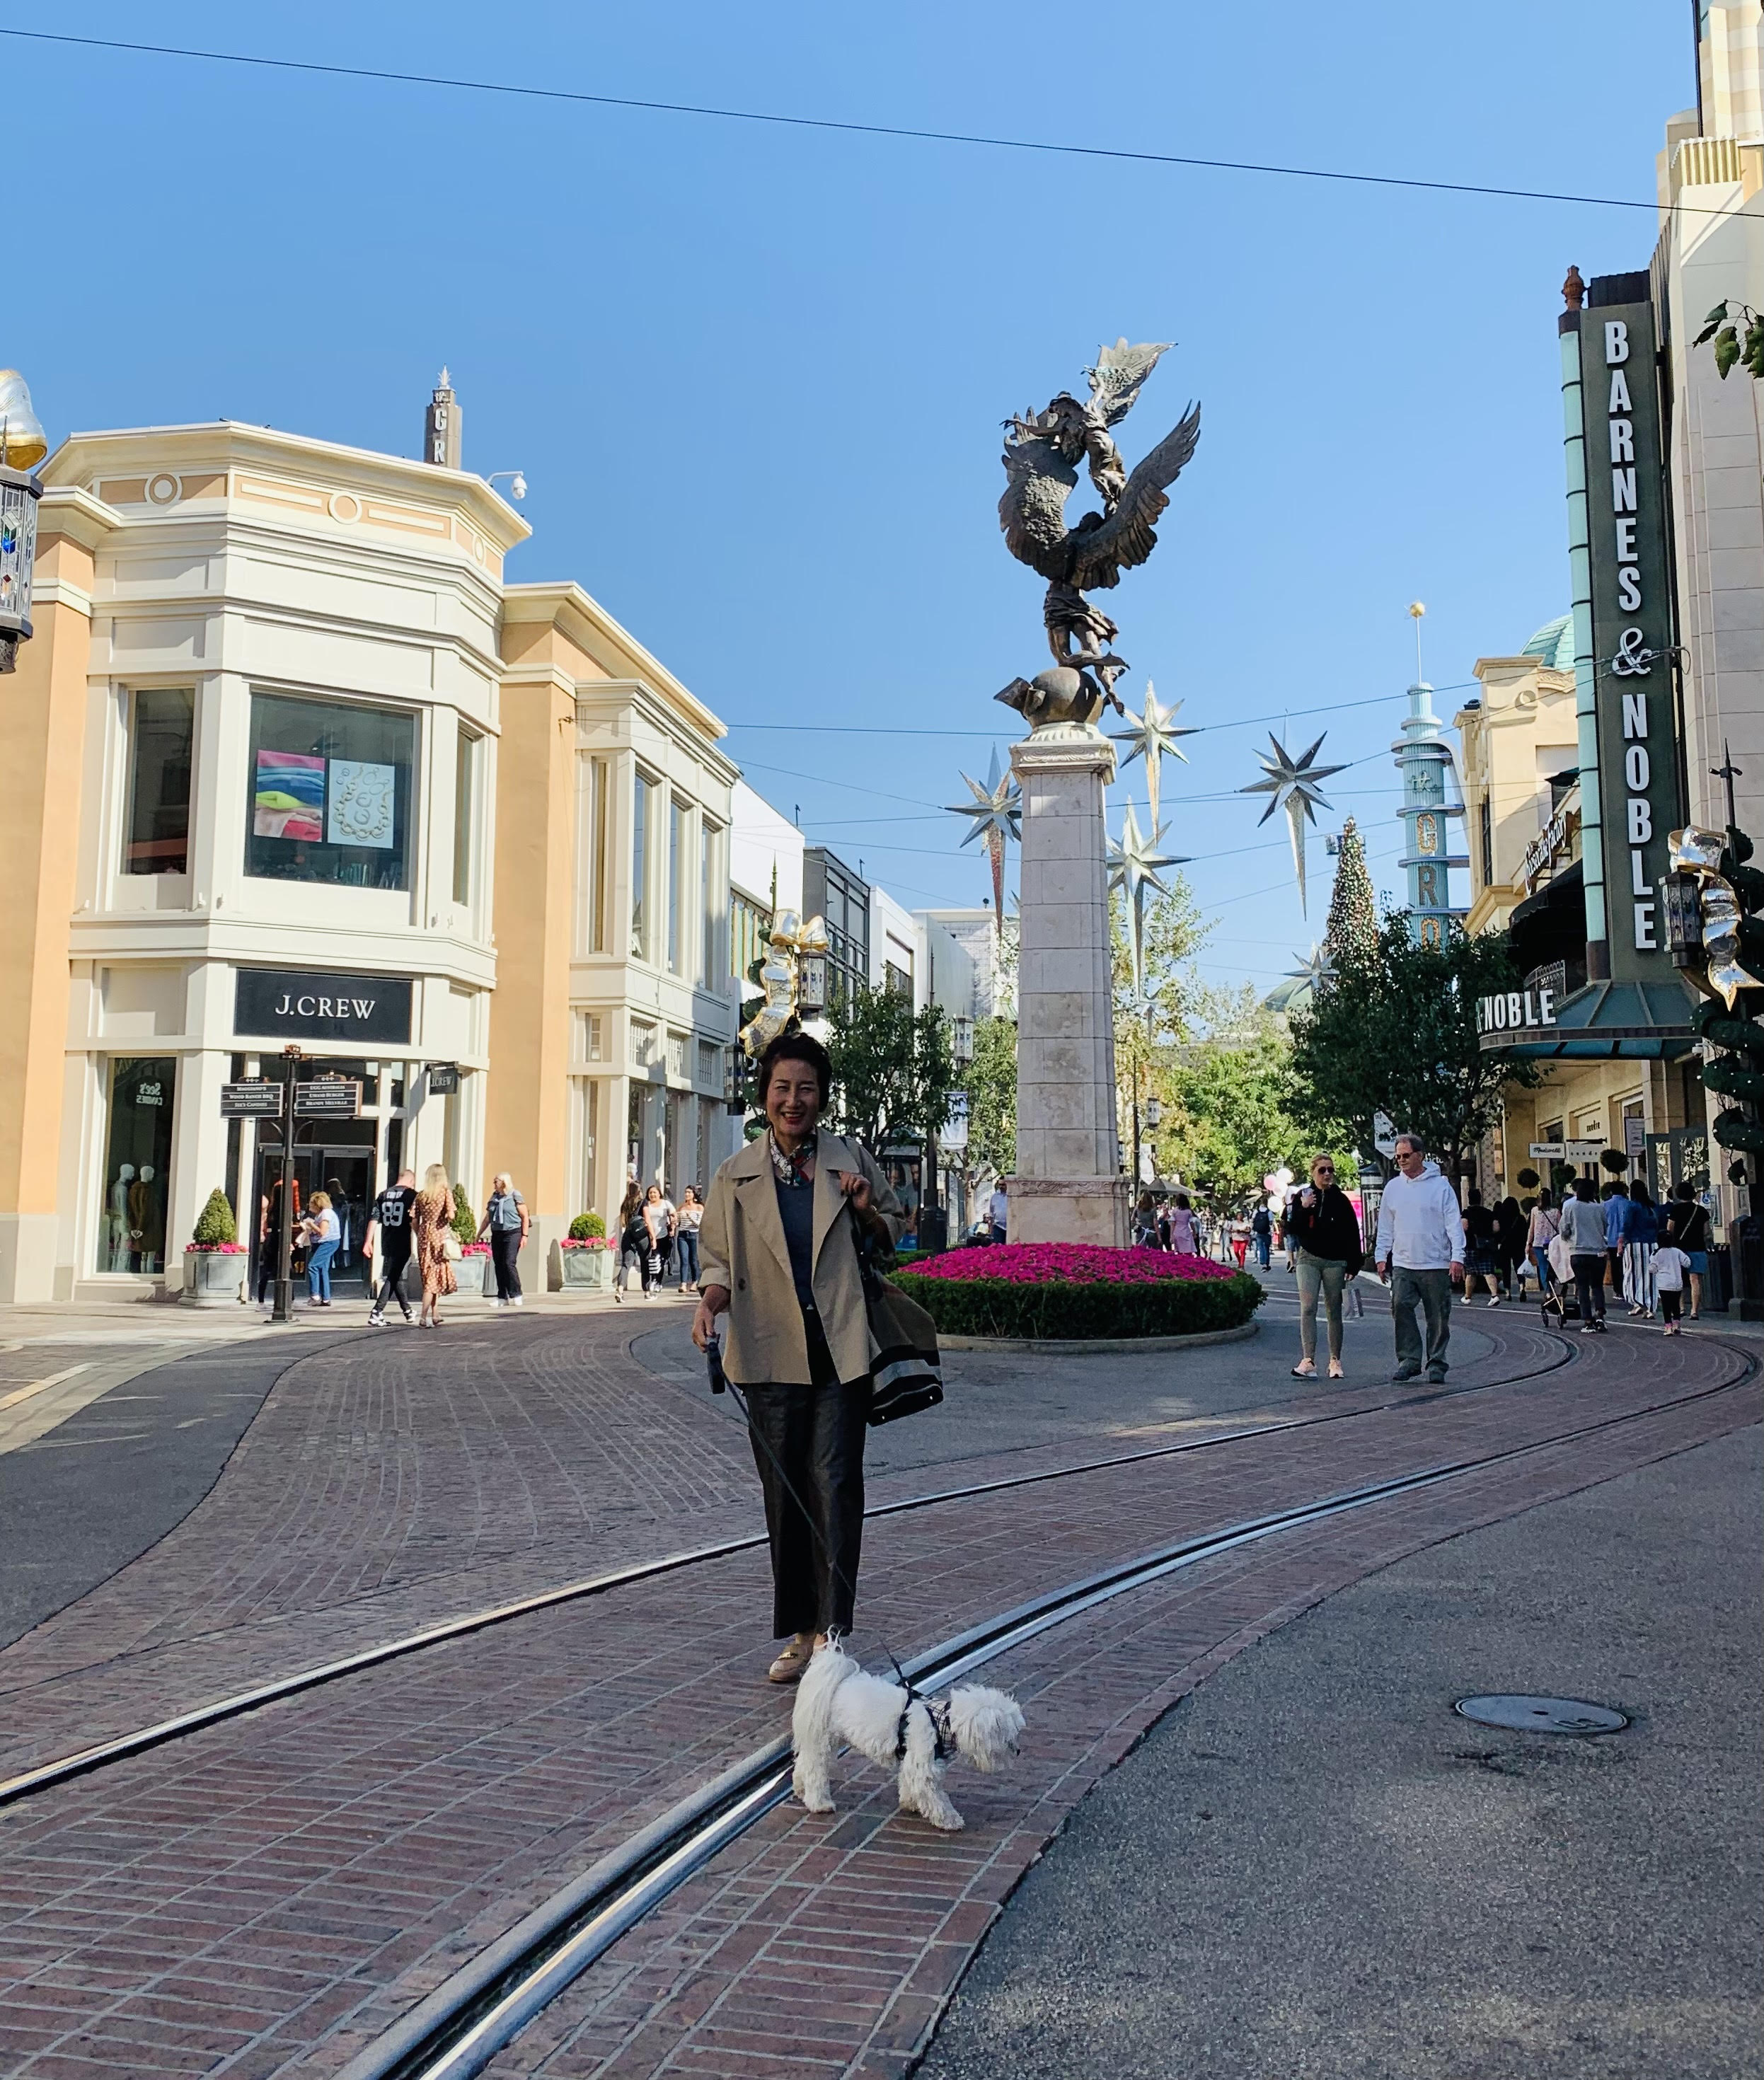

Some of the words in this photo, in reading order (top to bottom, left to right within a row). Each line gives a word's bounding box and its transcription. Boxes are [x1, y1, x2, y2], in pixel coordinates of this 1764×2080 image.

[1604, 320, 1642, 611] BARNES
[1612, 627, 1651, 675] &
[1622, 693, 1656, 949] NOBLE
[275, 994, 376, 1019] J.CREW
[1484, 989, 1557, 1031] NOBLE
[381, 1201, 405, 1227] 89
